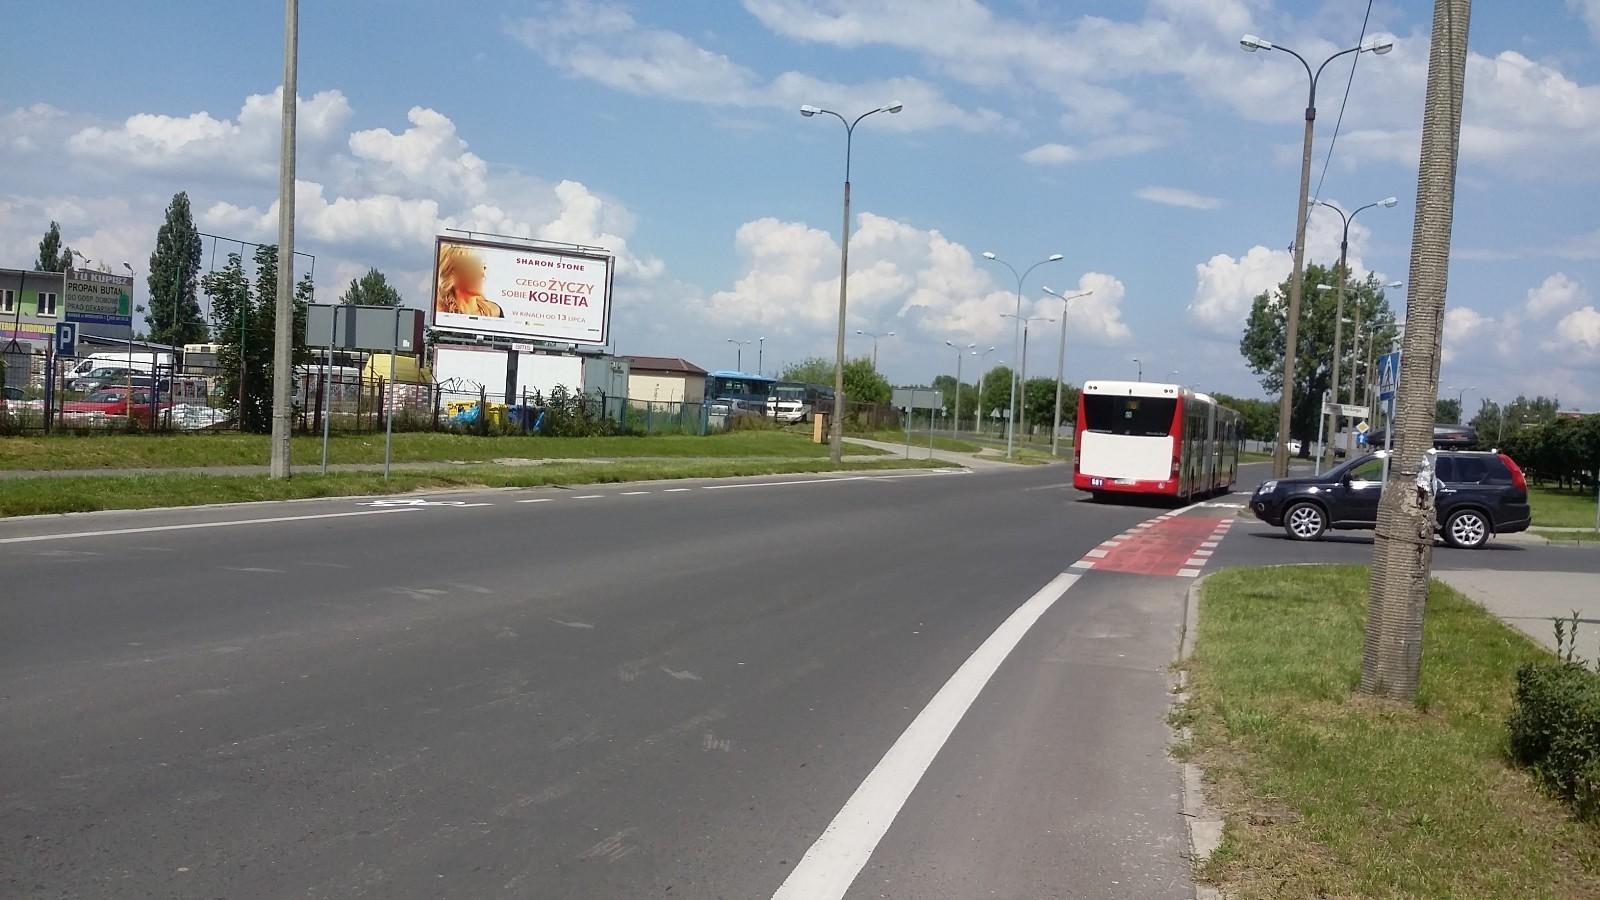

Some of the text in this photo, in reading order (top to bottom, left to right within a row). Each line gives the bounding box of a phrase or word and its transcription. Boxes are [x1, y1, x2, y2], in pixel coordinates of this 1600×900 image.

[516, 258, 585, 271] SHARON STONE
[74, 271, 128, 285] TU KUPISZ
[68, 282, 123, 297] PROPAN BUTAN
[515, 277, 595, 295] CZEGO ŻYCZY
[501, 289, 589, 308] SOBIE KOBIETA
[519, 311, 545, 319] KINACH
[557, 313, 567, 321] 13
[61, 326, 71, 349] P
